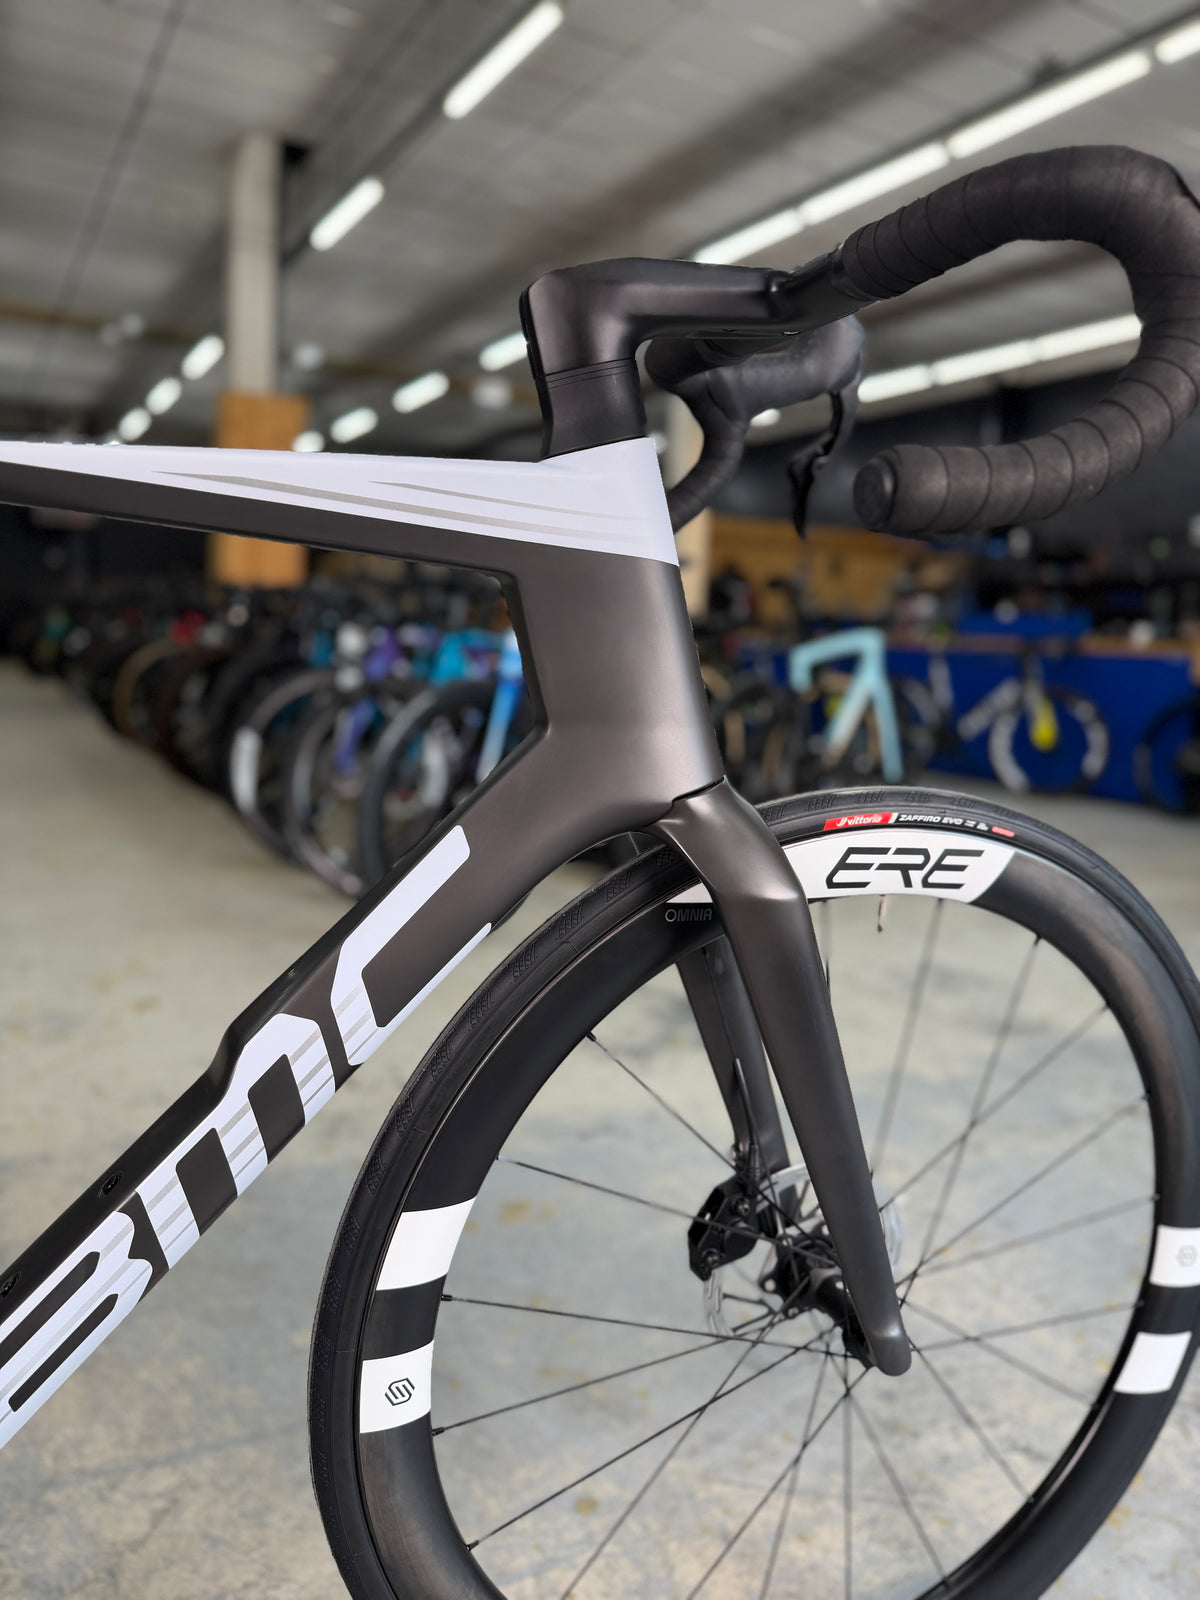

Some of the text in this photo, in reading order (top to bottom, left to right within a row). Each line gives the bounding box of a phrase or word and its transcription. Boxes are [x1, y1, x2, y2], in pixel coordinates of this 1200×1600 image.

[898, 814, 941, 823] ZAFFIRO
[942, 816, 963, 825] EVO
[826, 846, 985, 889] ERE
[665, 908, 712, 922] OMNIA
